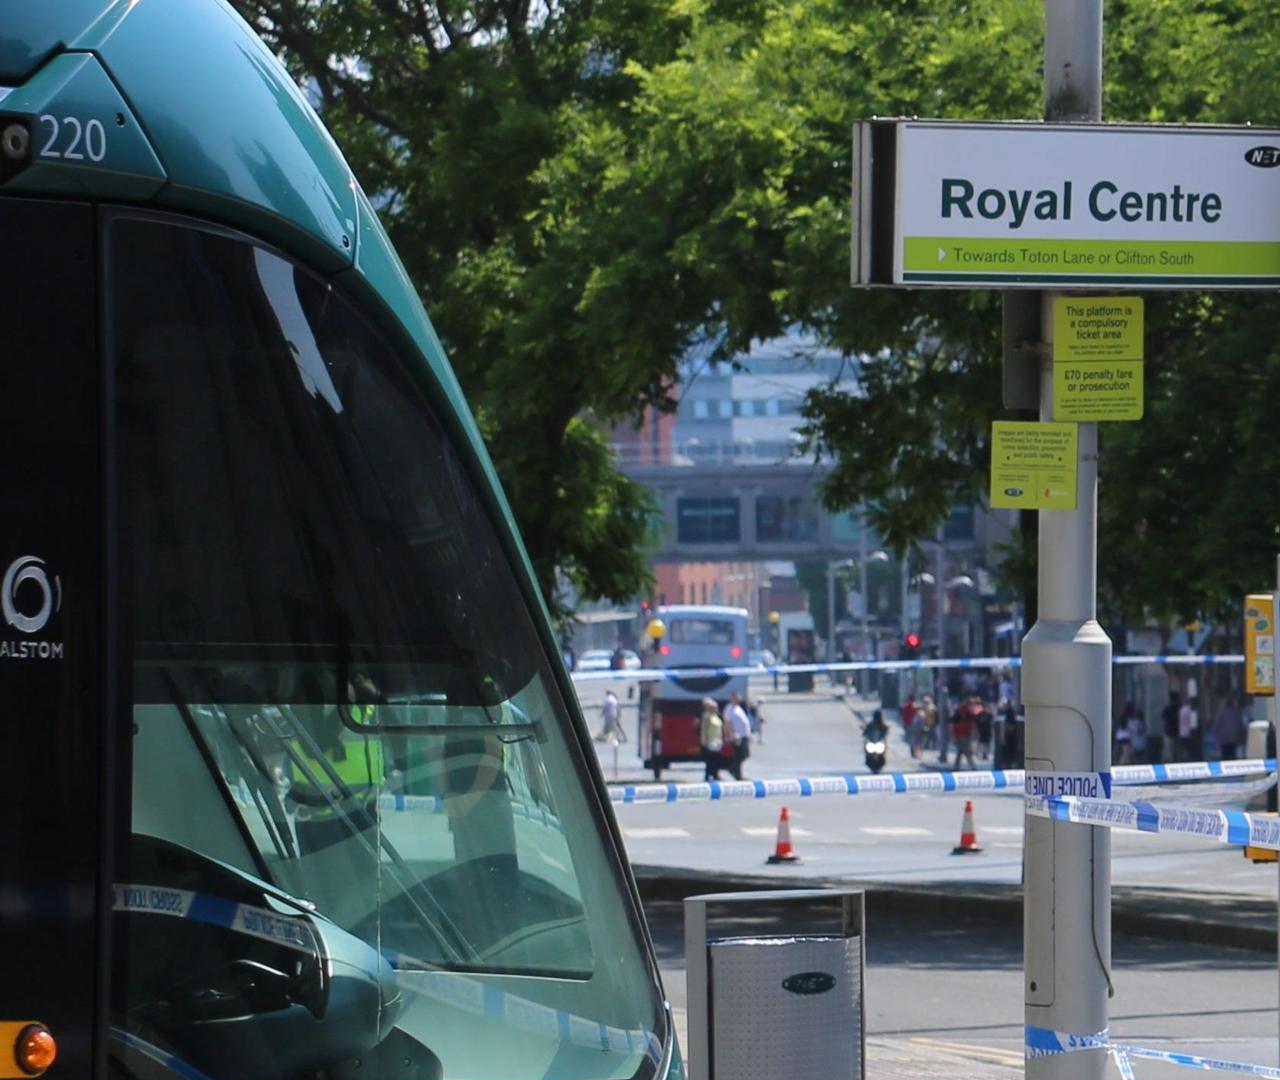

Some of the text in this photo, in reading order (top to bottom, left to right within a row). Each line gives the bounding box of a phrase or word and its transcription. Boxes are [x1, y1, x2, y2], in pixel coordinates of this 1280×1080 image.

[39, 114, 107, 164] 220
[1250, 150, 1280, 164] NET
[941, 178, 1222, 229] Royal Centre
[953, 247, 1194, 265] Towards Toton Lane or Clifton South
[1066, 306, 1132, 317] This platform is
[1070, 318, 1128, 329] a compulsory
[1077, 330, 1122, 340] ticket area
[1064, 369, 1134, 381] £70 penalty fare
[1068, 382, 1130, 393] or prosecution
[0, 640, 64, 659] ALSTOM
[1033, 776, 1054, 796] LINE
[1058, 777, 1098, 798] POLICE
